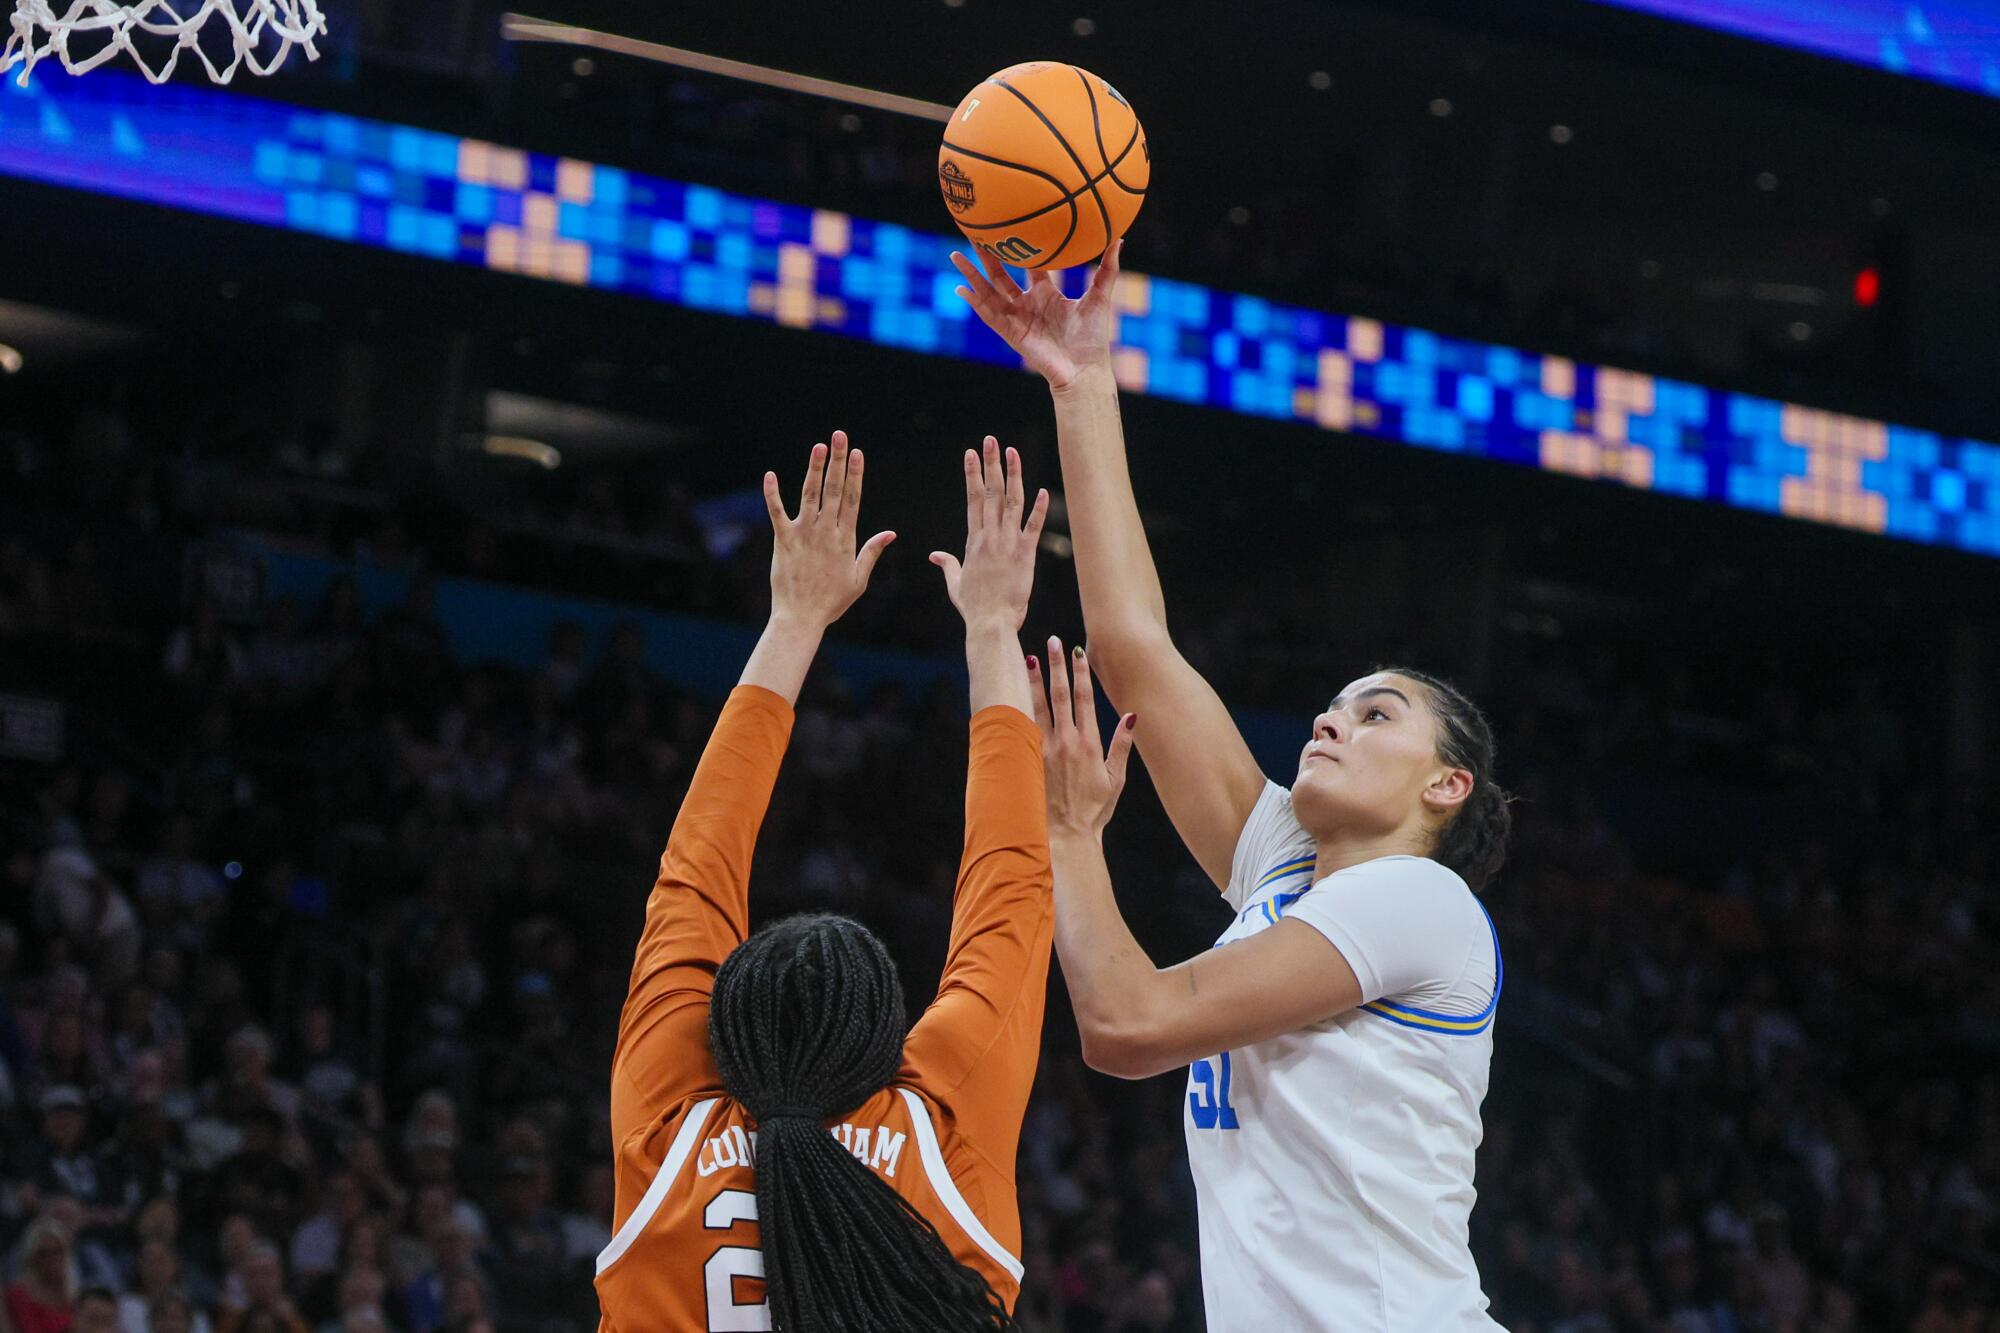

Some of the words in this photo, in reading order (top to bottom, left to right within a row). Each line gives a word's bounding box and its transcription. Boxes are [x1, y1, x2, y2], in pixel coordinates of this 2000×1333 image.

[951, 182, 973, 201] FINAL
[1189, 1050, 1240, 1129] 51
[697, 1123, 907, 1178] CUNHAM
